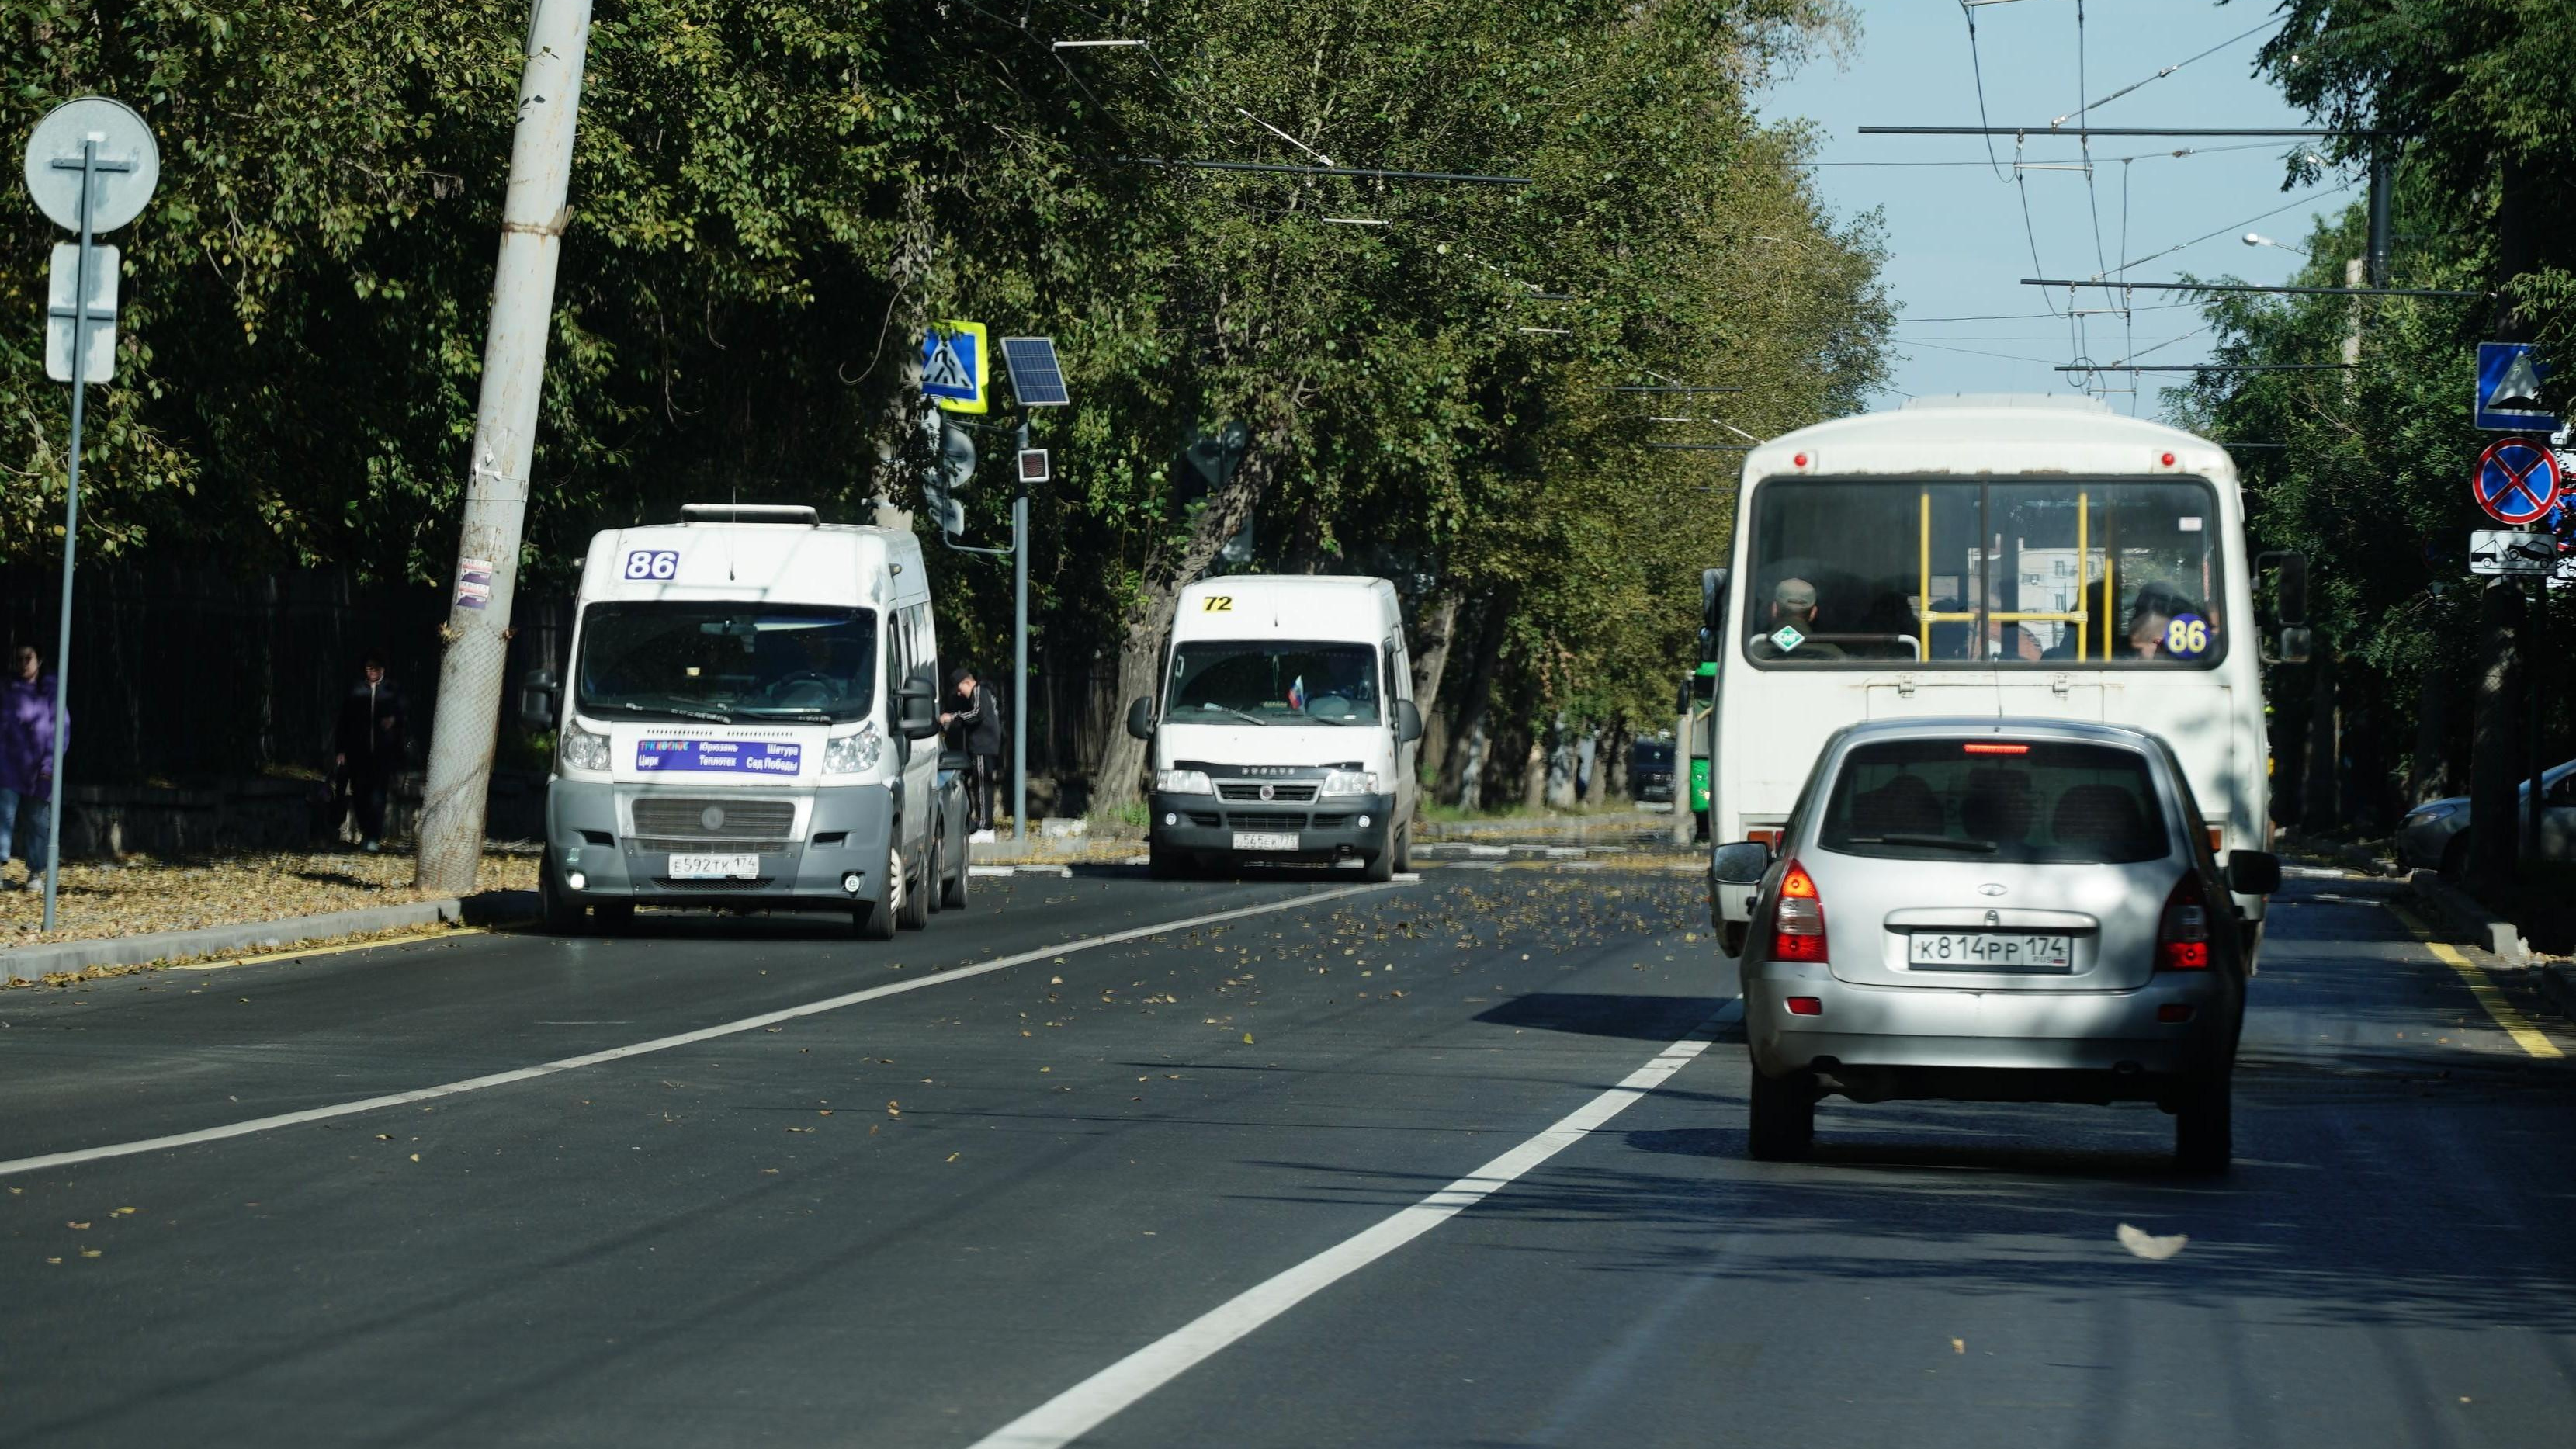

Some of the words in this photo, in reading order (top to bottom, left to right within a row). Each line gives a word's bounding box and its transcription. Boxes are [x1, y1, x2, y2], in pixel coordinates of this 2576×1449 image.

[627, 552, 677, 578] 86
[1205, 597, 1232, 610] 72
[2168, 619, 2207, 653] 86
[699, 741, 738, 754] Юрюзань
[767, 744, 799, 757] Шатура
[639, 754, 659, 768] Цирк
[699, 755, 737, 767] Теплотех
[746, 757, 763, 770] Сад
[764, 757, 798, 771] Победы
[2026, 937, 2064, 956] 174
